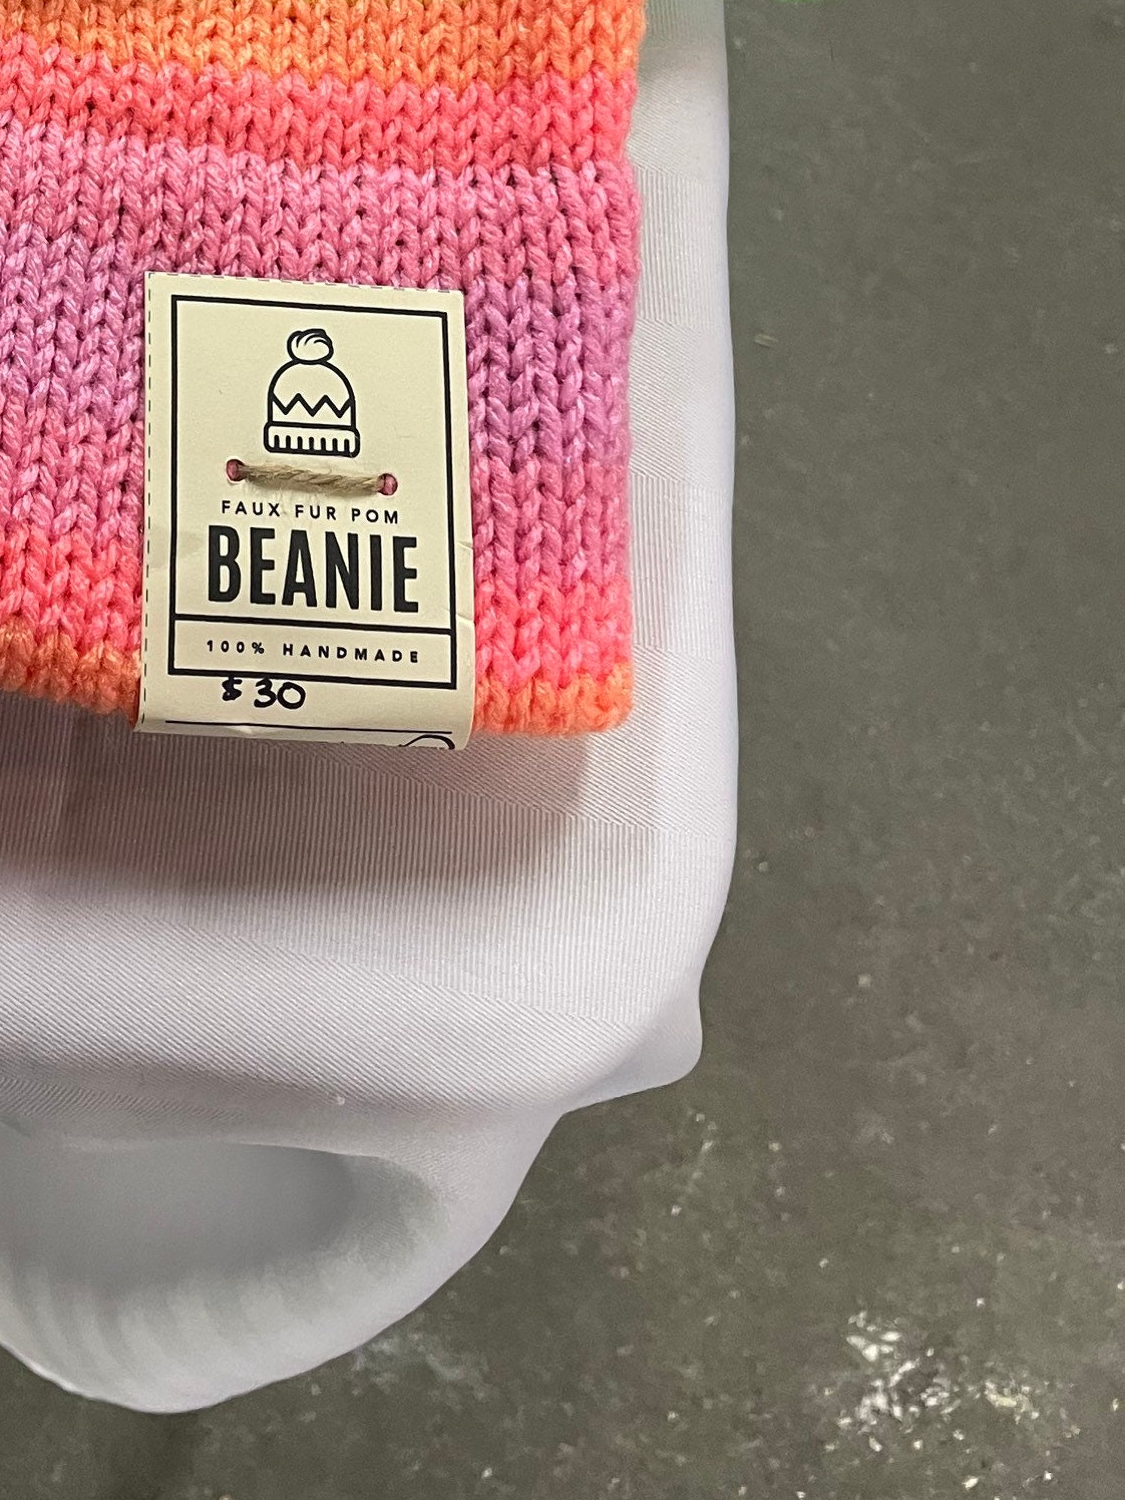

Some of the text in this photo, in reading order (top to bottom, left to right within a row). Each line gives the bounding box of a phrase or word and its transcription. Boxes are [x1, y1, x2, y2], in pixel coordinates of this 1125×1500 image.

[221, 499, 398, 525] FAUX FUR POM
[207, 524, 419, 613] BEANIE
[206, 639, 418, 664] 100% HANDMADE
